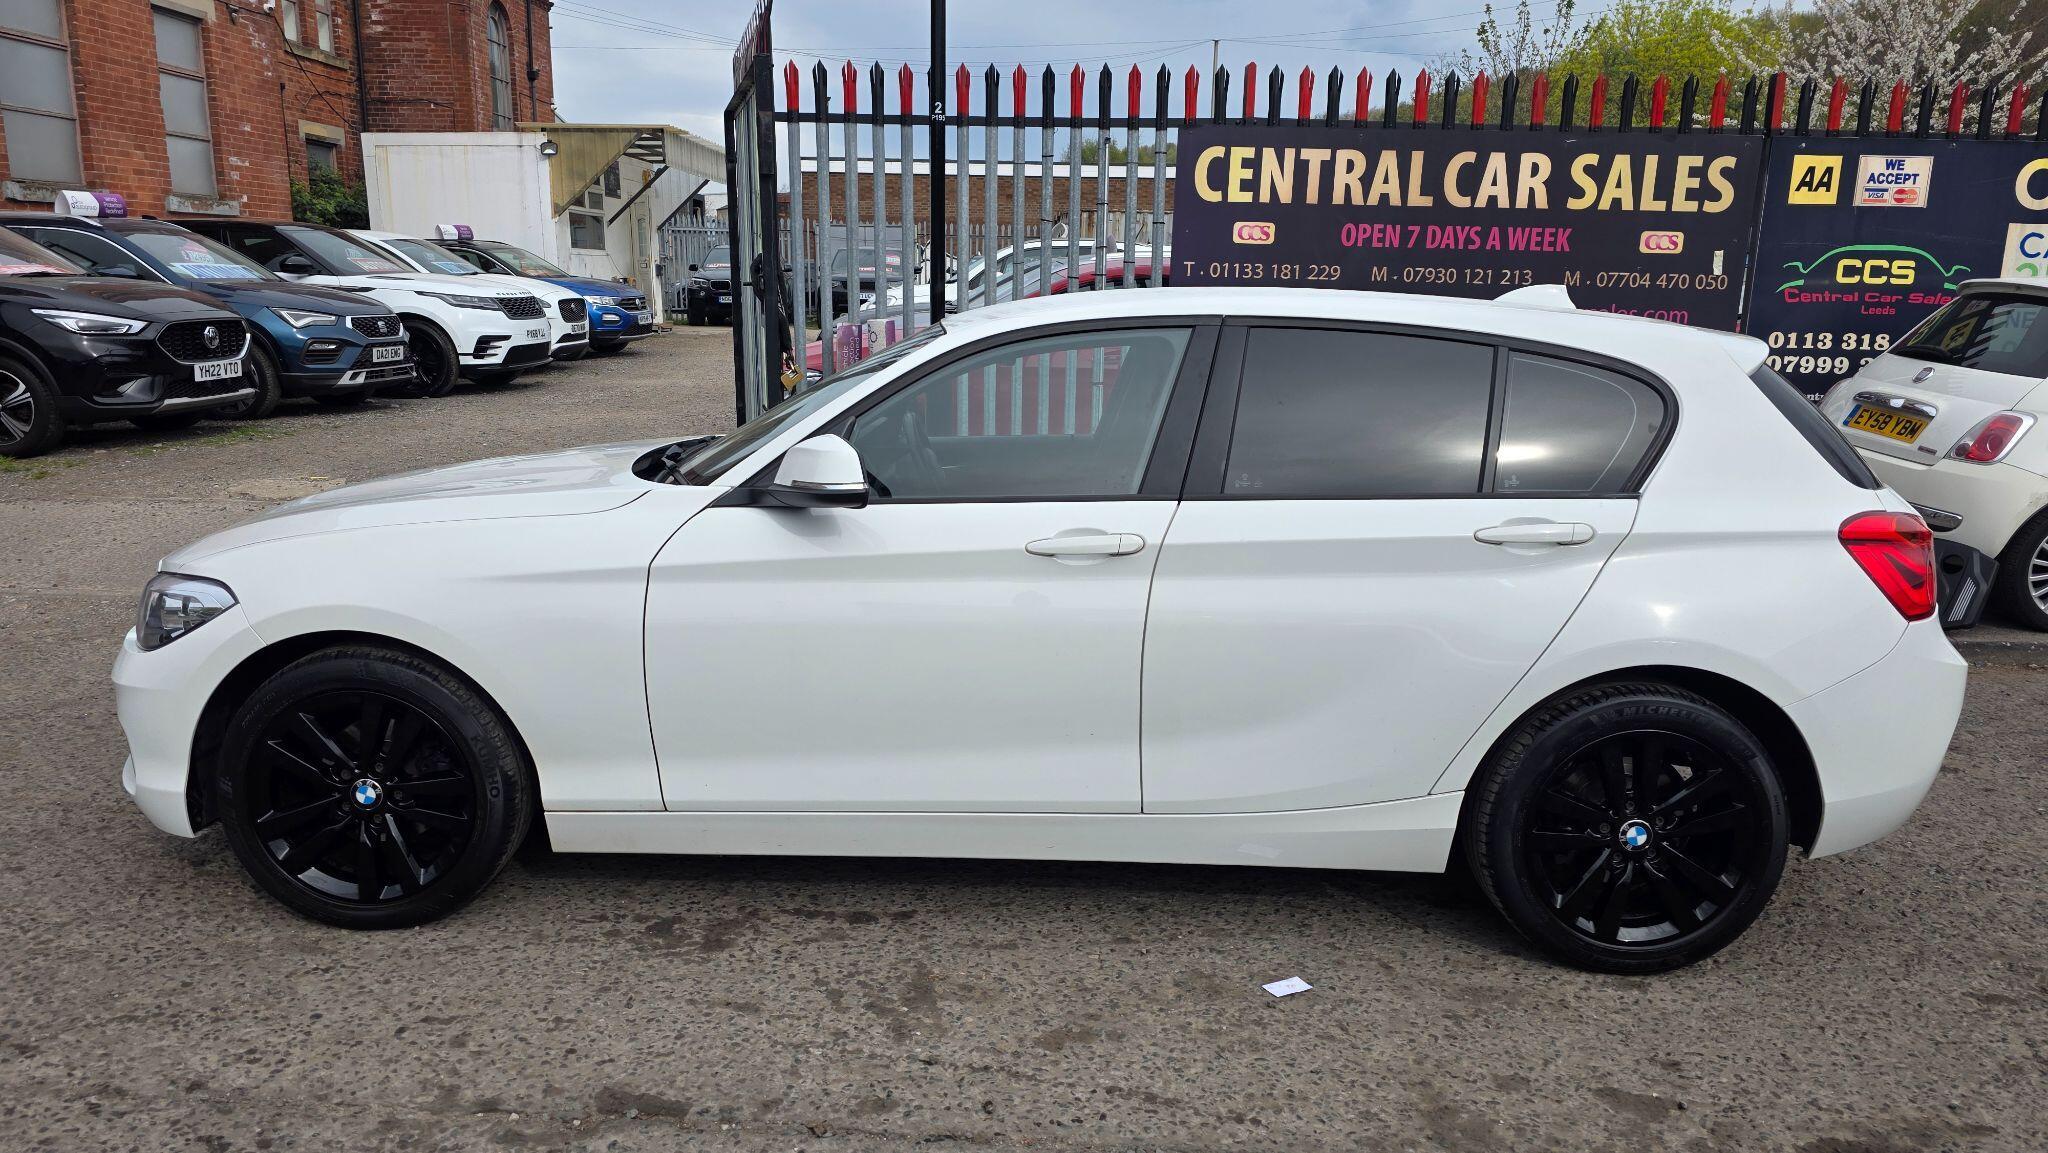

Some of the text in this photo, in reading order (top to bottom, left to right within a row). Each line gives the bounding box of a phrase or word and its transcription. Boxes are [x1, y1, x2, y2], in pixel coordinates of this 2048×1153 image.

[935, 101, 942, 113] 2
[1886, 159, 1905, 170] WE
[1194, 145, 1738, 213] CENTRAL CAR SALES
[1794, 166, 1834, 192] AA
[1867, 173, 1919, 185] ACCEPT
[1341, 223, 1573, 251] OPEN 7 DAYS A WEEK
[2019, 232, 2048, 258] C
[1210, 262, 1264, 279] 01133
[1272, 264, 1300, 280] 181
[1307, 264, 1341, 281] 229
[1403, 267, 1457, 284] 07930
[1464, 268, 1492, 285] 121
[1500, 269, 1532, 285] 213
[1596, 271, 1650, 288] 07704
[1656, 273, 1690, 289] 470
[1695, 273, 1728, 290] 050
[1835, 258, 1916, 285] CCS
[1784, 288, 1952, 304] Central Car Sale
[1861, 305, 1896, 315] Leeds
[1768, 331, 1890, 351] 0113 318
[199, 362, 239, 379] YH22 VTO
[1765, 355, 1850, 375] 07999
[1853, 408, 1923, 439] EY58 YBM
[1623, 705, 1704, 721] MICHELI
